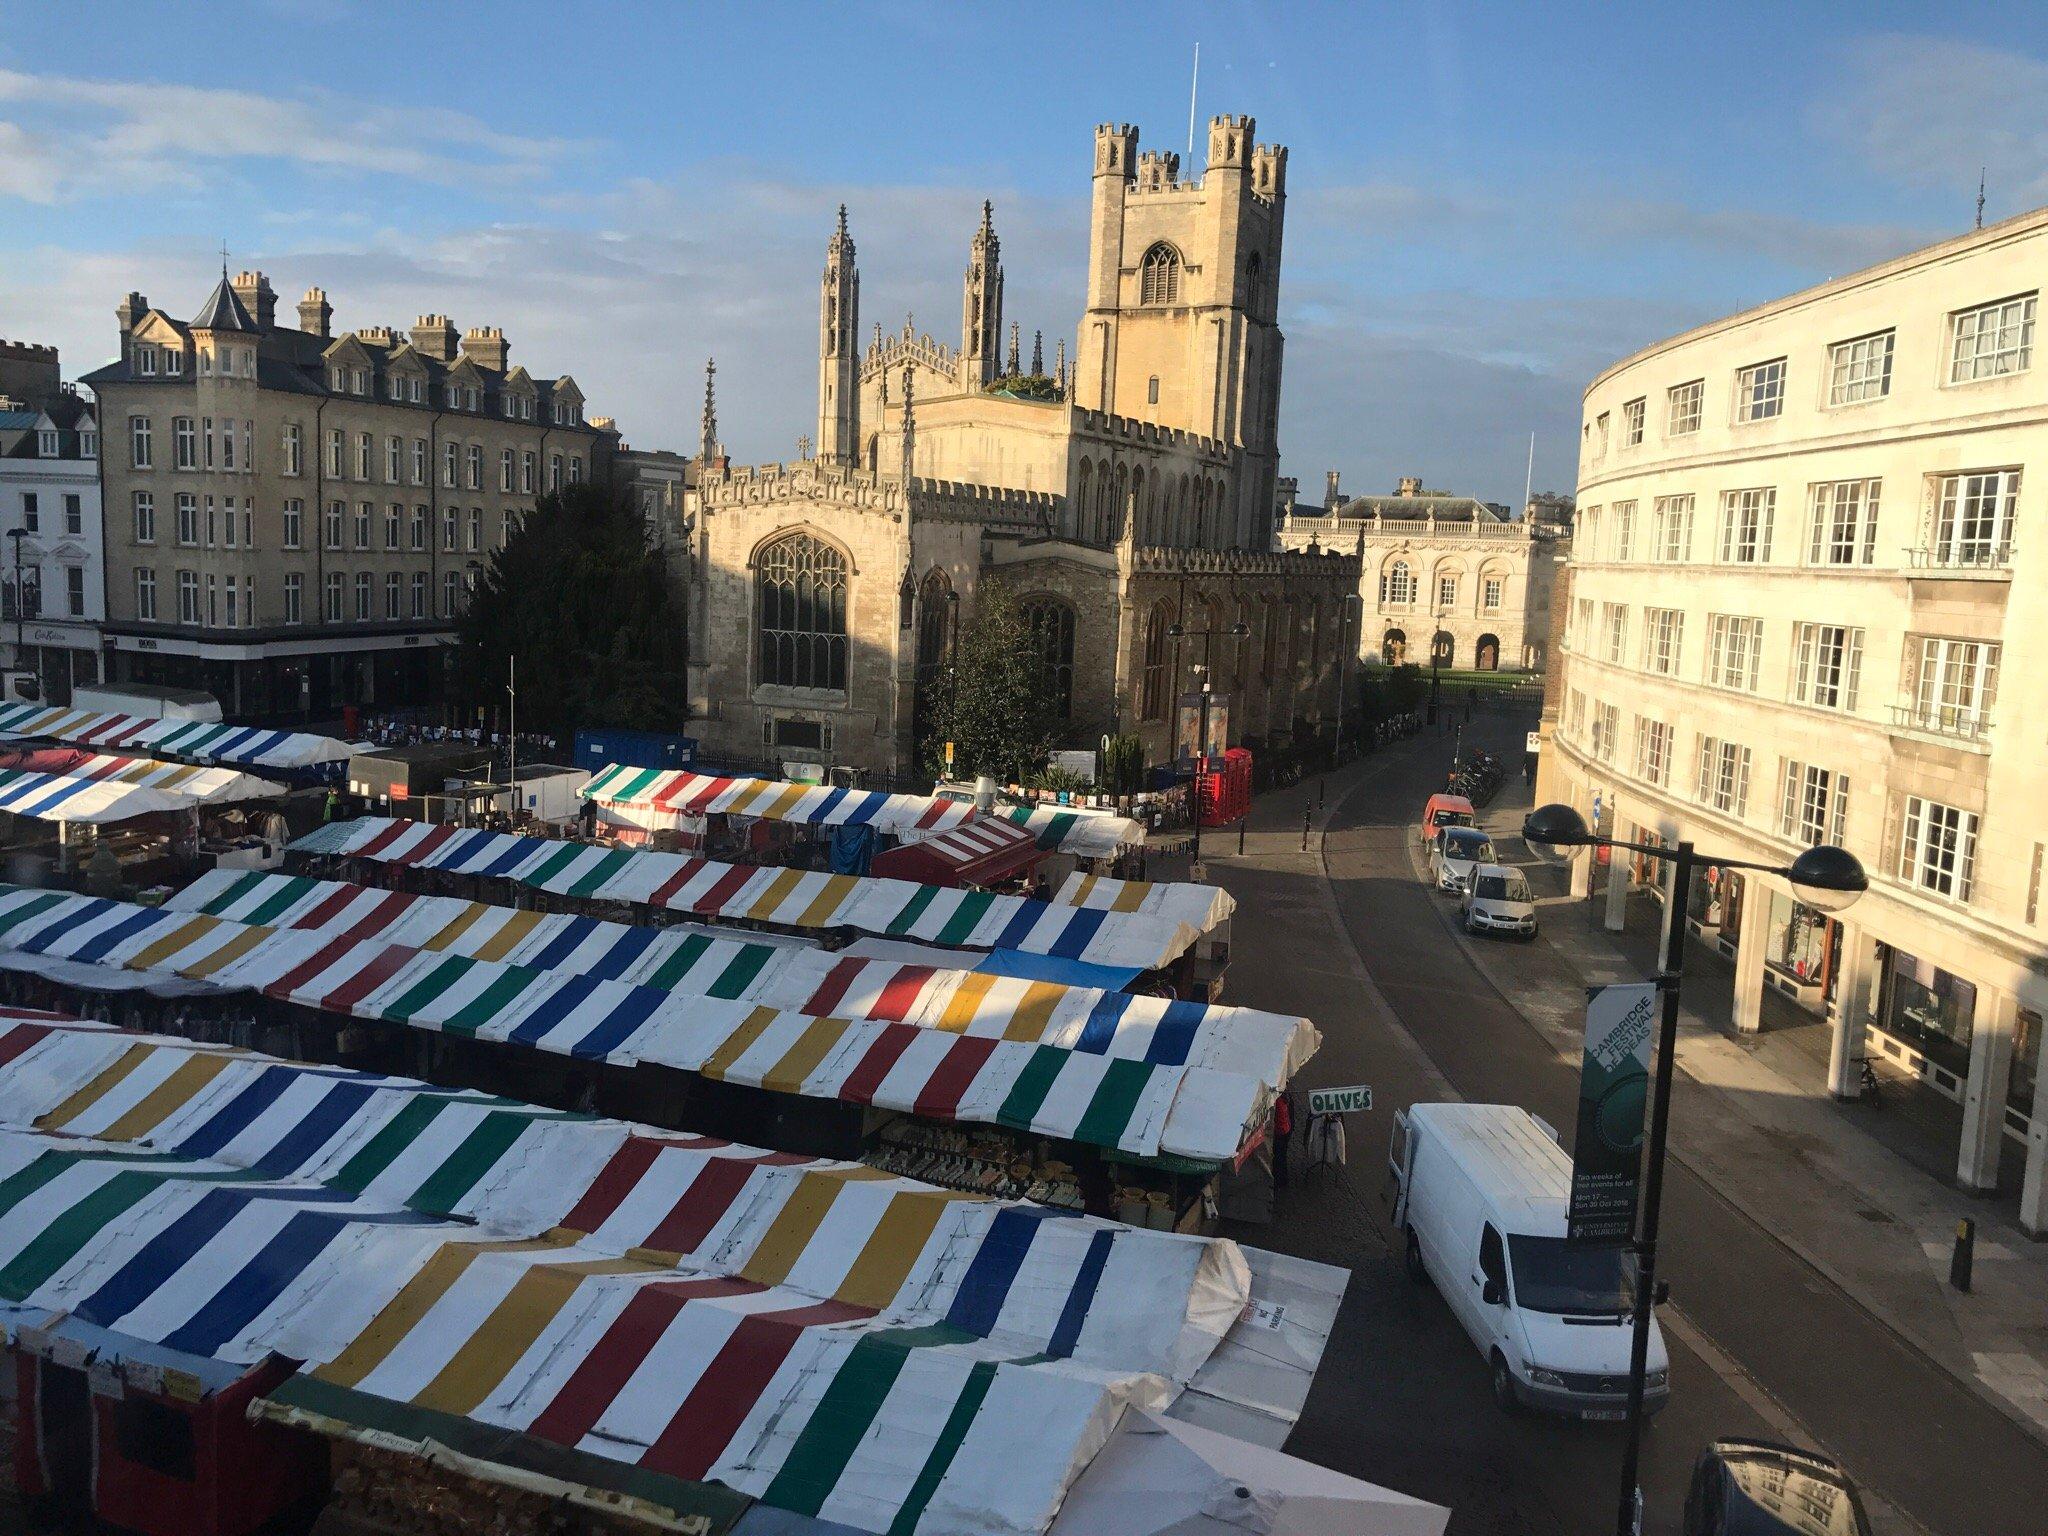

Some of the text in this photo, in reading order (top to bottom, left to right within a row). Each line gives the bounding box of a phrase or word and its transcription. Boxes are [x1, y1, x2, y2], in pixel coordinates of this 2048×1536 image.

[1591, 995, 1651, 1061] CAMBRIDGE
[1607, 1010, 1655, 1056] FESTIVAL
[1604, 1026, 1651, 1073] OF IDEAS
[1312, 1090, 1371, 1112] OLIVES
[1591, 1172, 1614, 1180] weeks
[1269, 1306, 1285, 1330] PARKING
